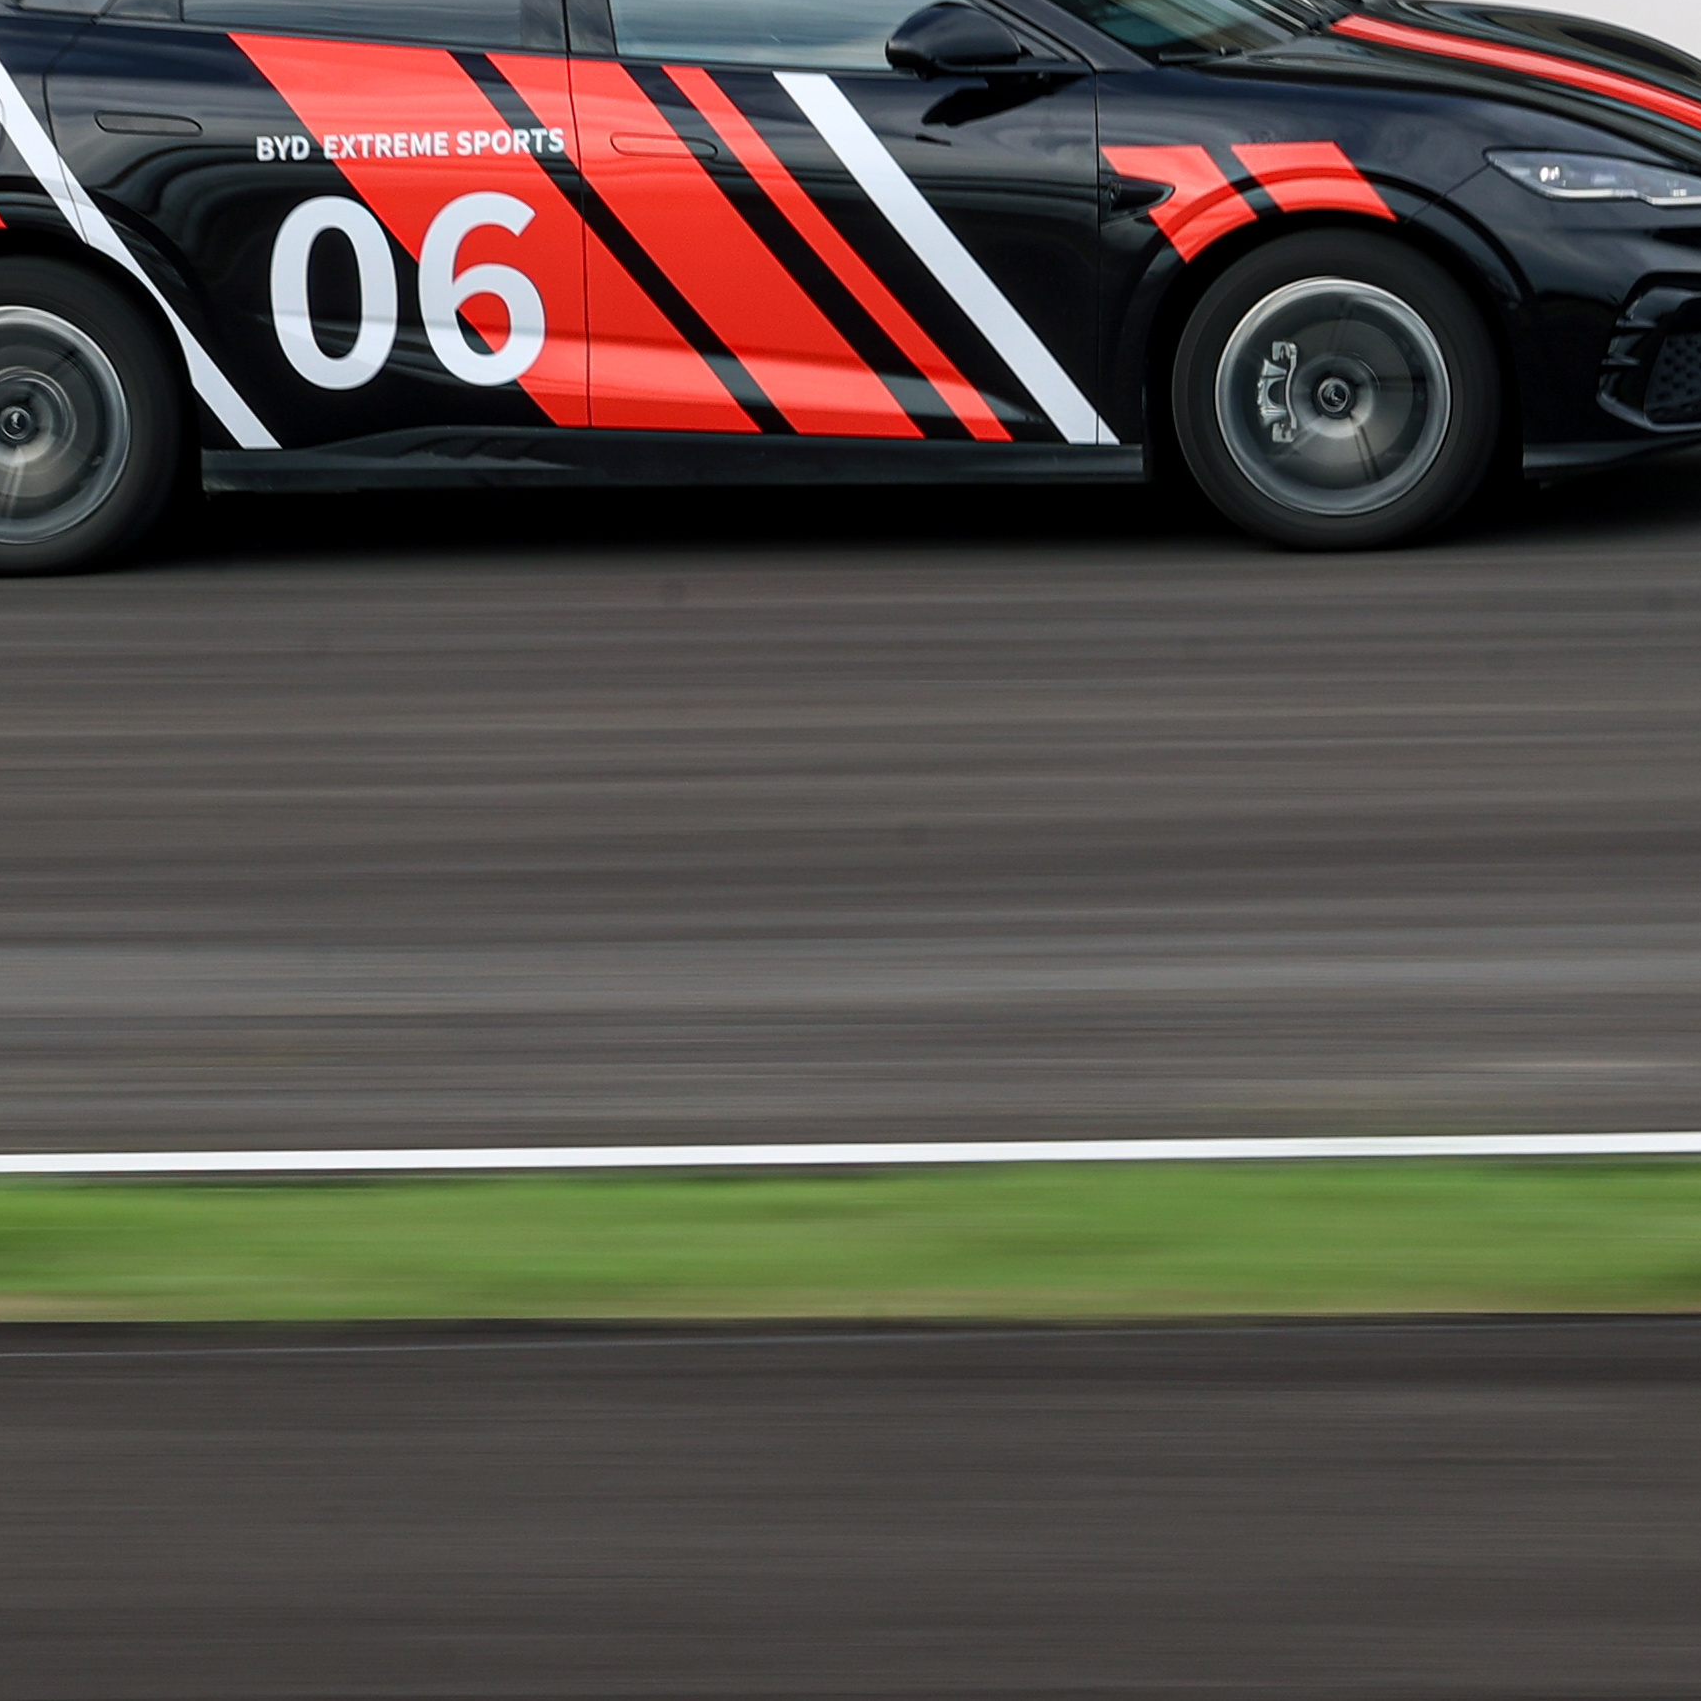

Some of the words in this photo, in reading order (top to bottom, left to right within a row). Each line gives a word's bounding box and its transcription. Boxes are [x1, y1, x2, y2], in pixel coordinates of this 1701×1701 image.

[256, 135, 310, 161] BYD
[323, 131, 449, 158] EXTREME
[456, 128, 565, 155] SPORTS
[270, 191, 546, 390] 06
